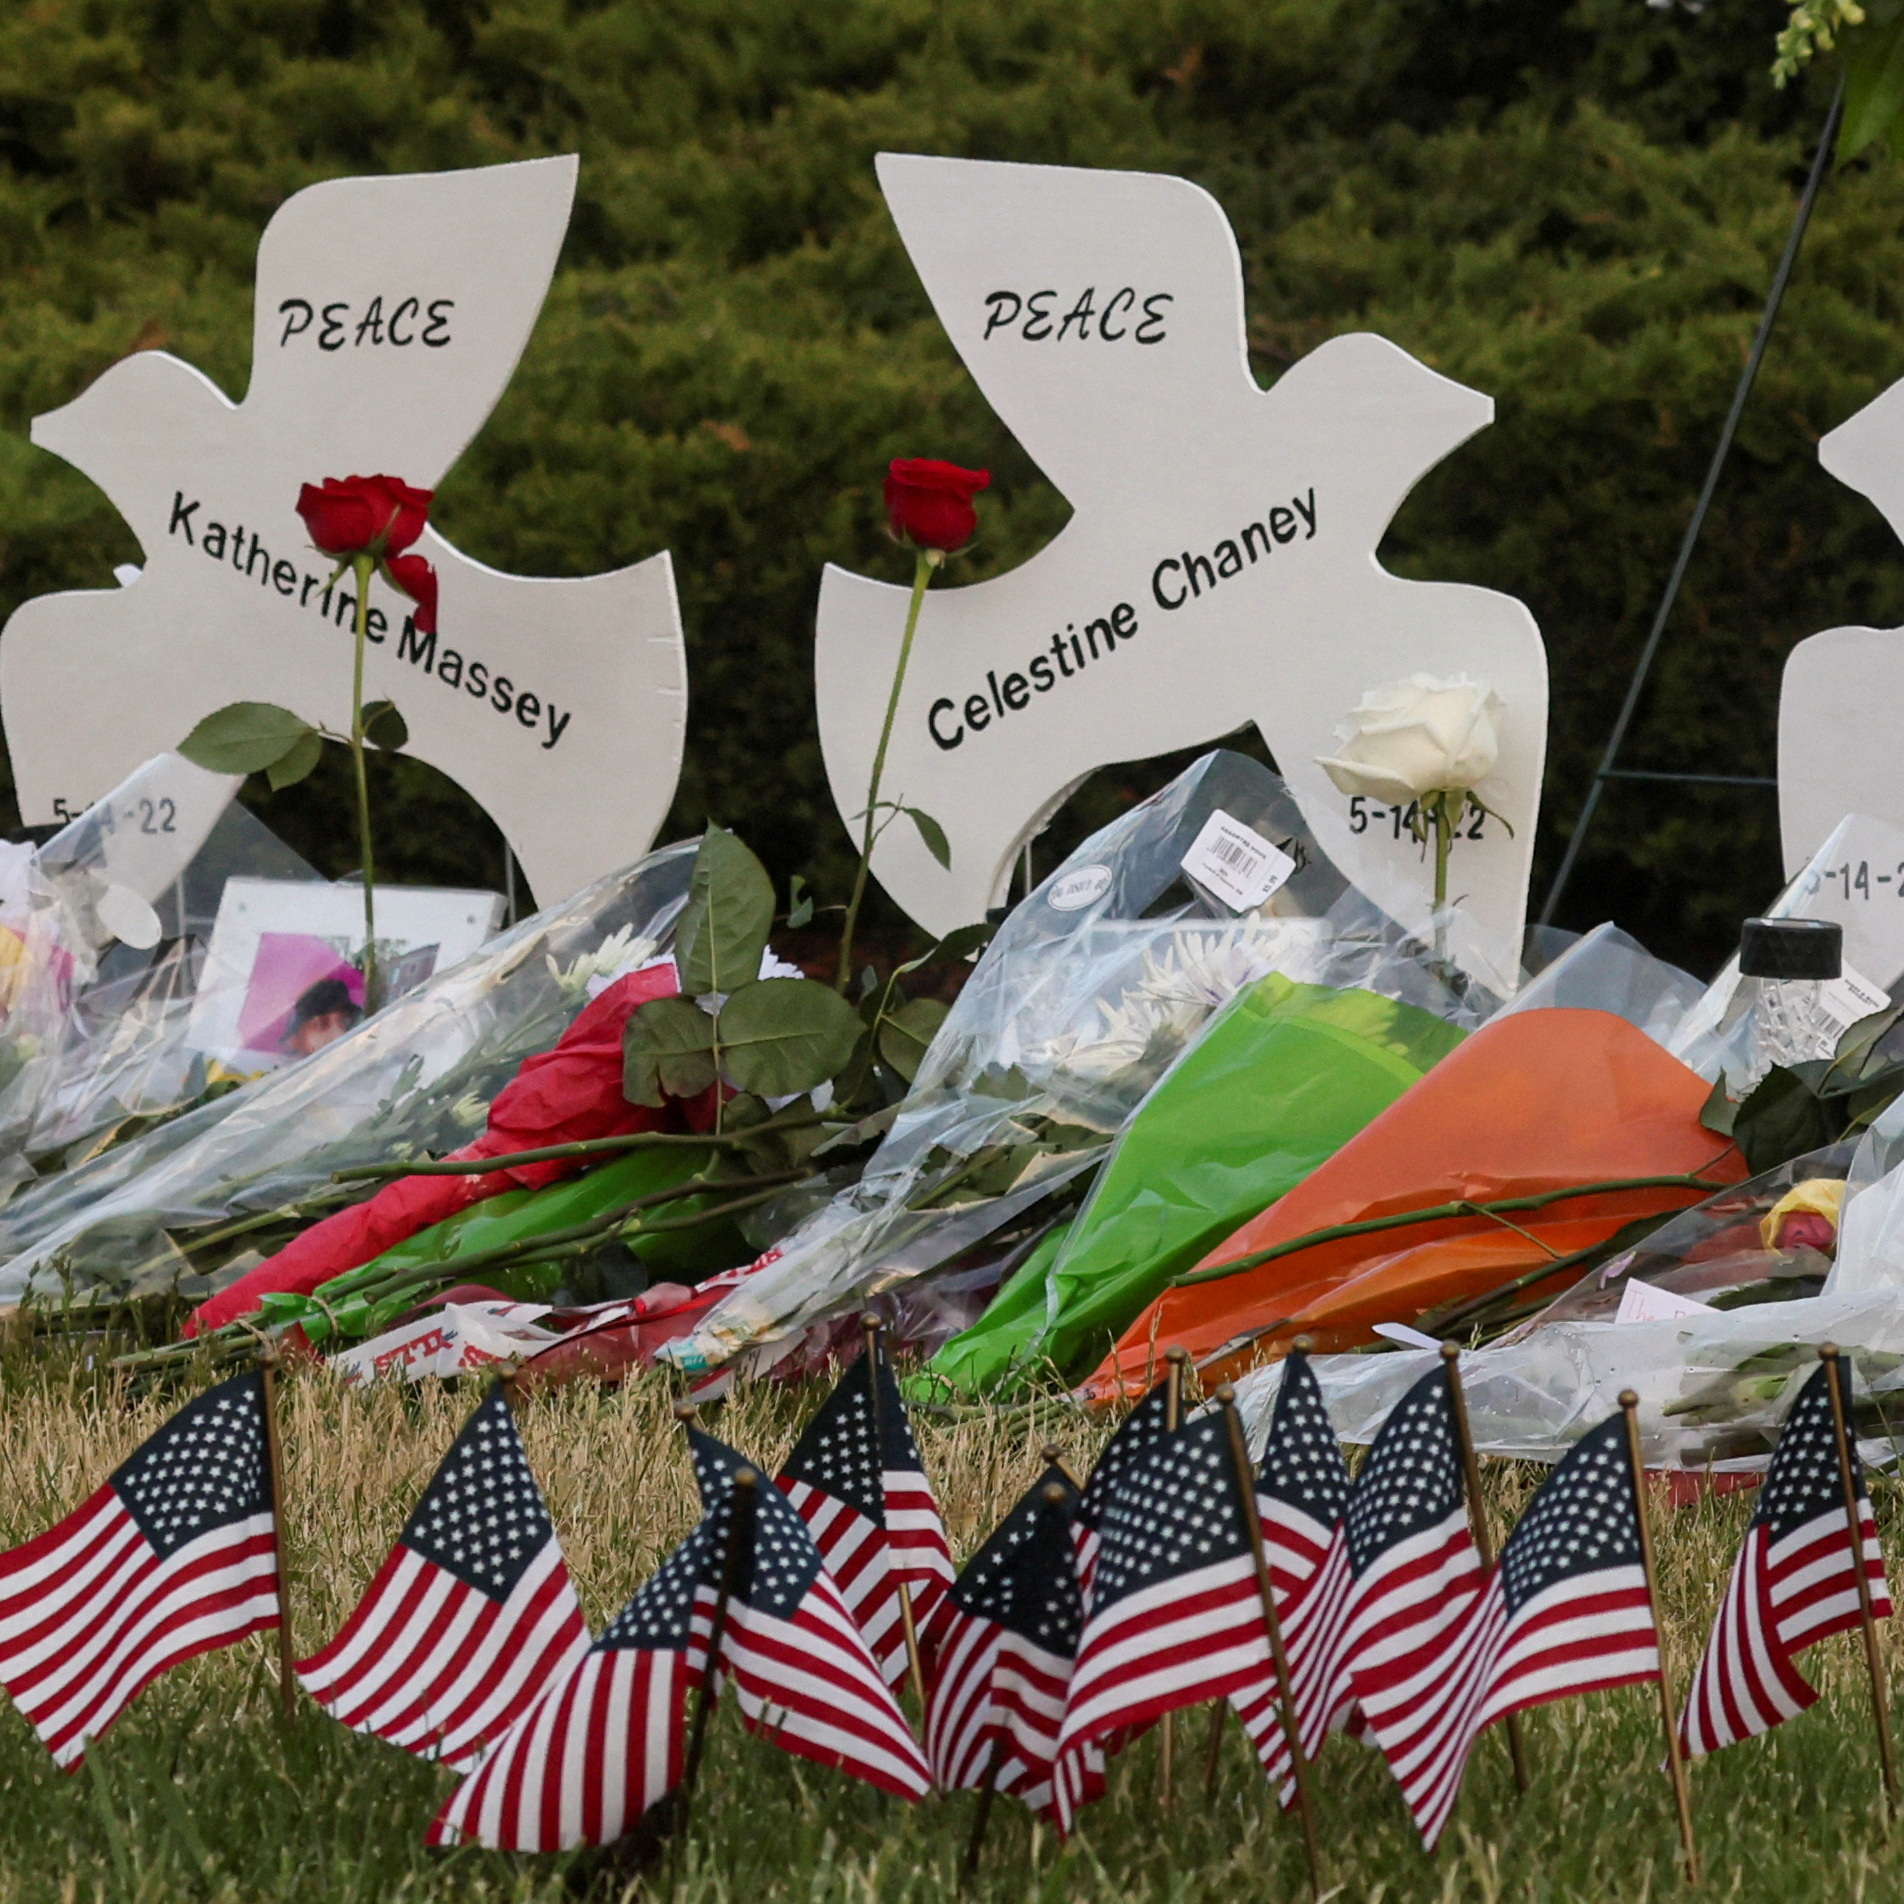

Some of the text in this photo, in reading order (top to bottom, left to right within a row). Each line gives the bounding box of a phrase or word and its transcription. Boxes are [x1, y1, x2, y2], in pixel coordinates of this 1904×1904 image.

[278, 295, 456, 351] PEACE
[985, 287, 1174, 346] PEACE
[167, 490, 572, 749] Katherine Massey
[927, 487, 1318, 752] Celestine Chaney
